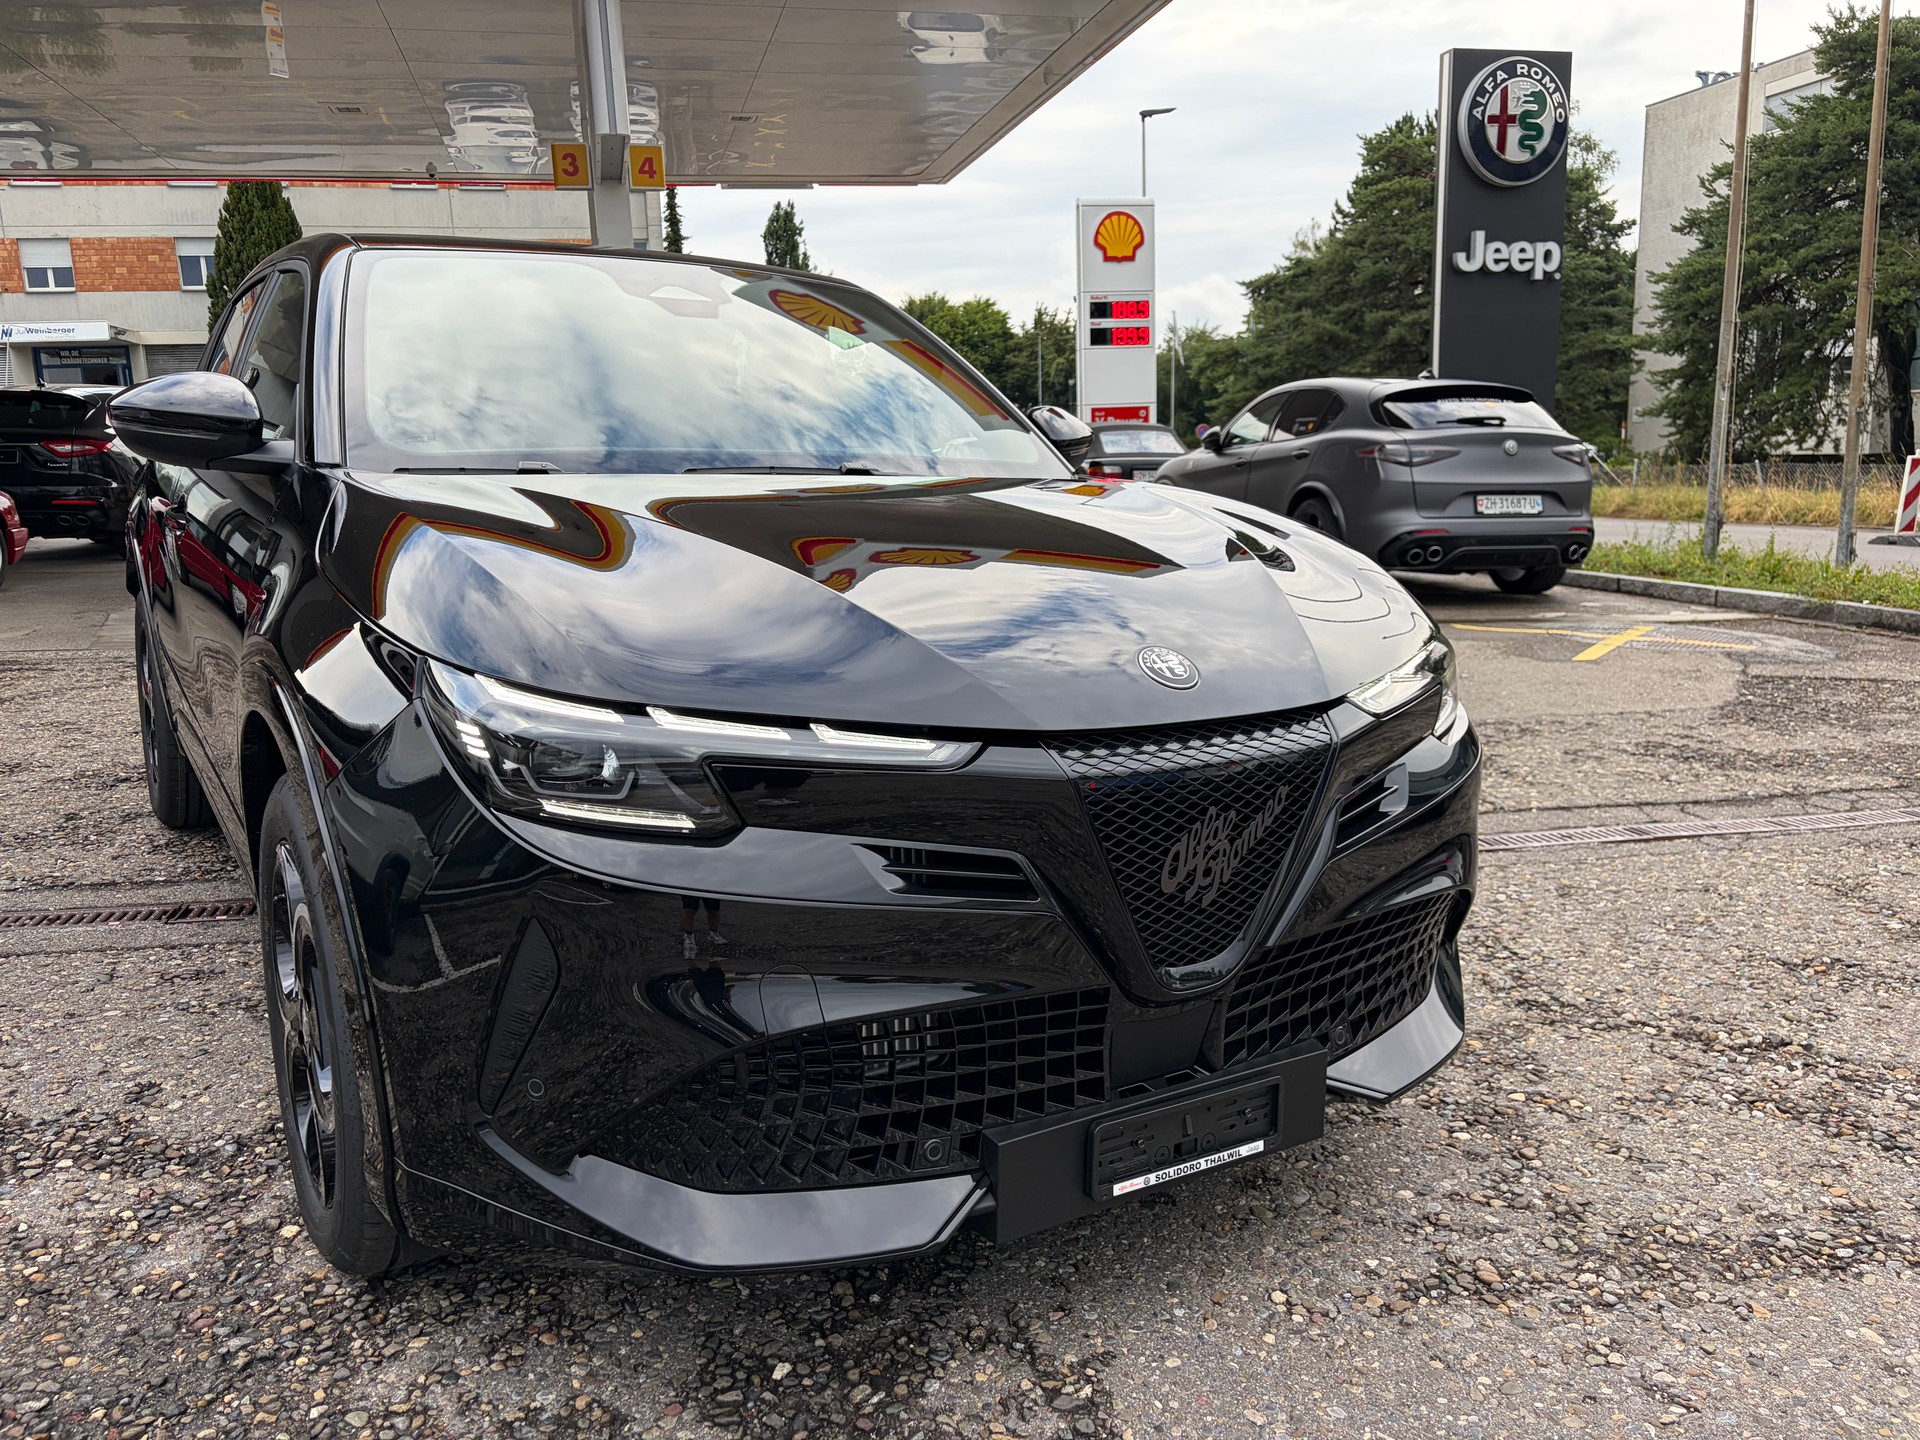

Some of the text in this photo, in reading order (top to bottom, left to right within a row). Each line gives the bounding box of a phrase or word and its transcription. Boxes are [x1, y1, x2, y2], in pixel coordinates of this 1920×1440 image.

[1472, 63, 1566, 123] ALFA ROMEO
[561, 152, 580, 177] 3
[637, 156, 657, 179] 4
[1452, 229, 1561, 280] Jeep
[1160, 805, 1237, 905] Alfa
[1199, 784, 1289, 909] Romeo
[1154, 1161, 1202, 1183] SOLIDORO
[1203, 1149, 1243, 1167] THALWIL
